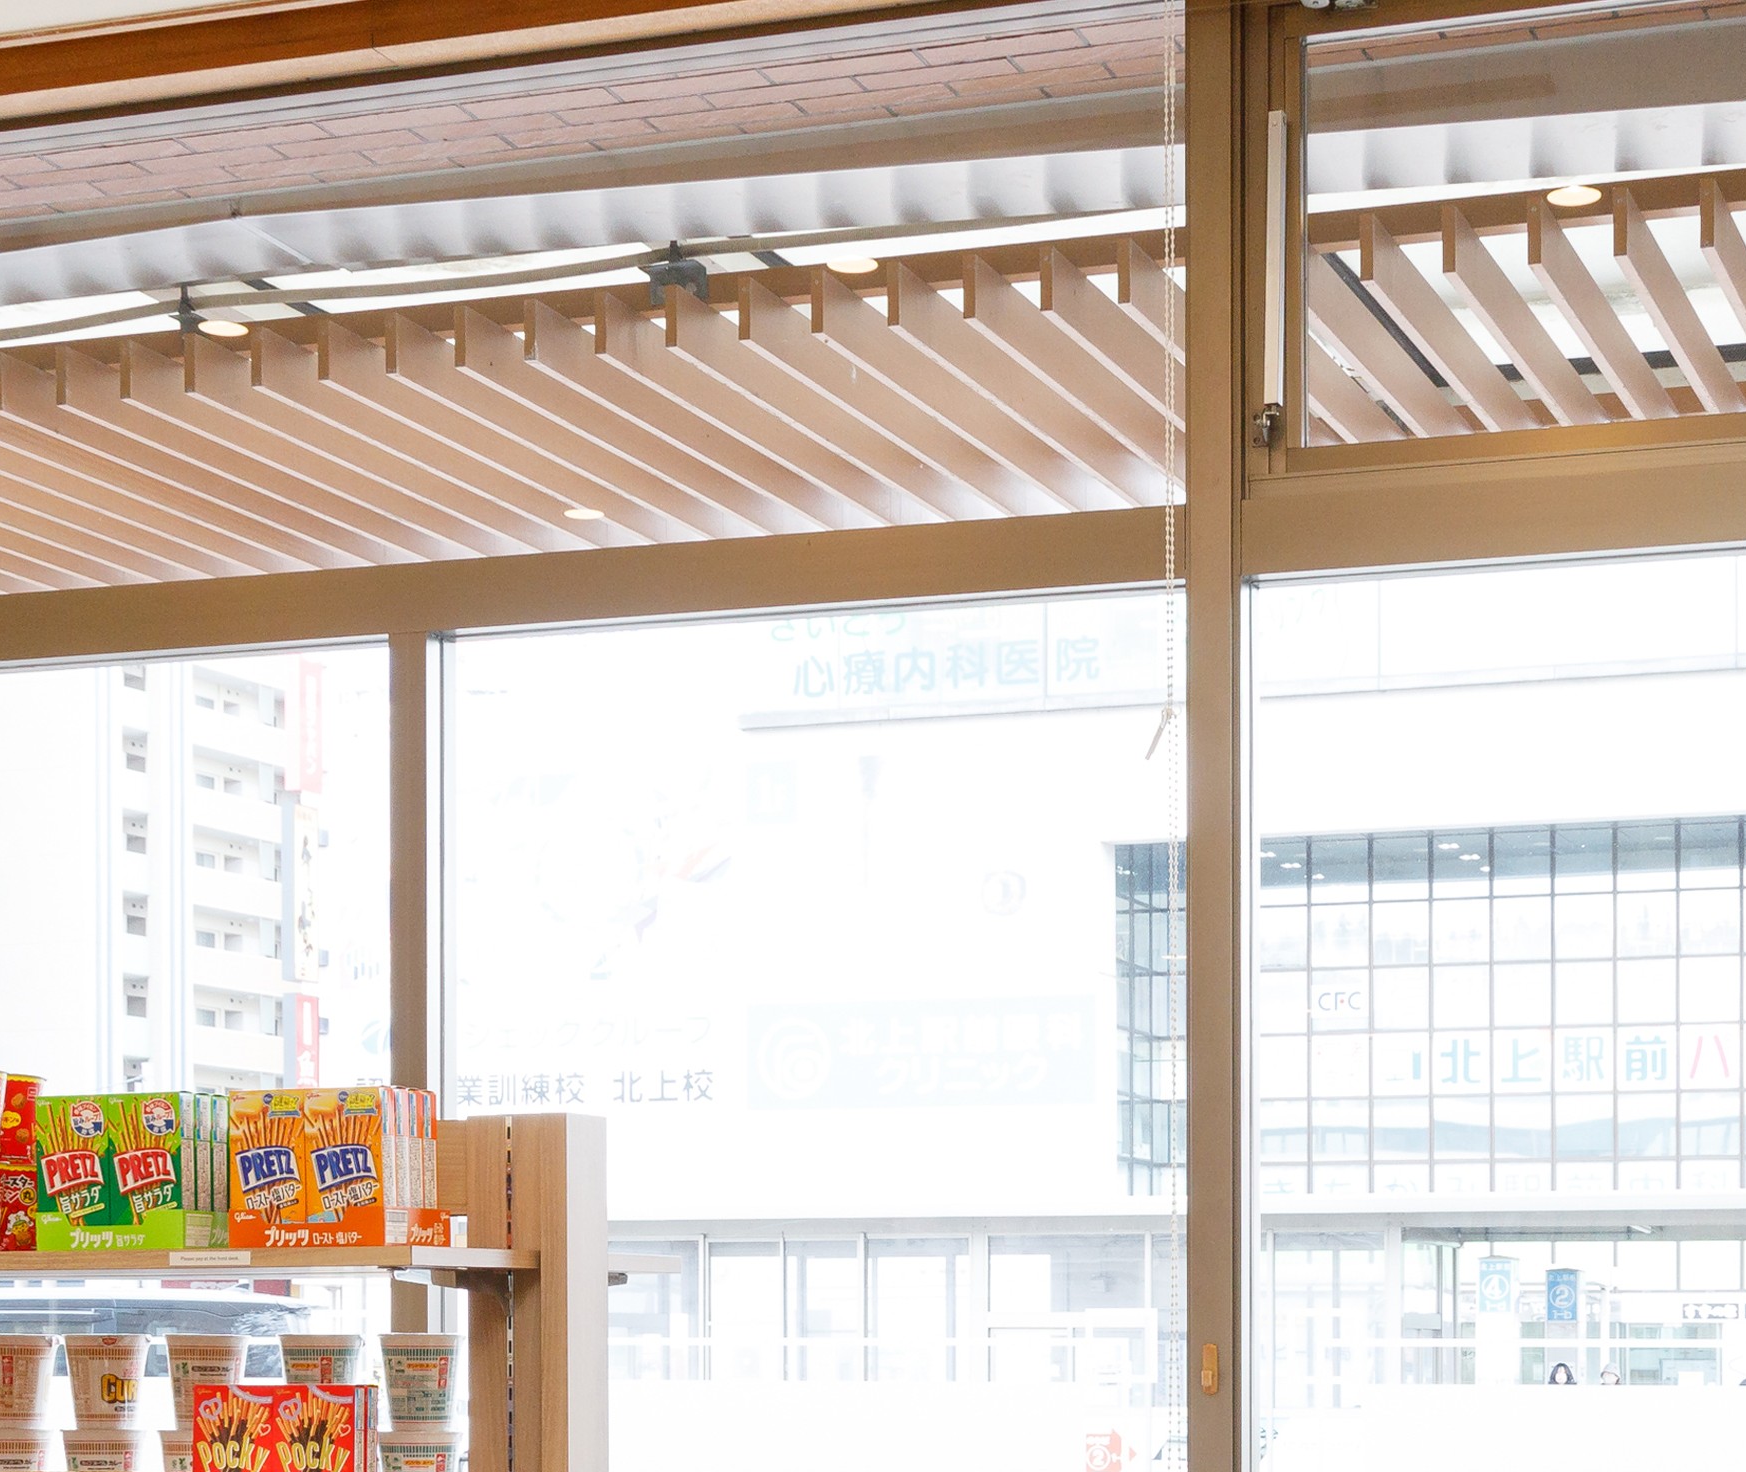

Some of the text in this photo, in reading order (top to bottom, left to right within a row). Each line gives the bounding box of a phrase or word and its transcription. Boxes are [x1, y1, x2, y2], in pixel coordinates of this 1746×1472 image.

[45, 1153, 99, 1189] PRETZ
[118, 1151, 172, 1188] PRETZ
[239, 1150, 296, 1185] PRETZ
[316, 1149, 374, 1183] PRETZ
[70, 1229, 113, 1248] プリッツ
